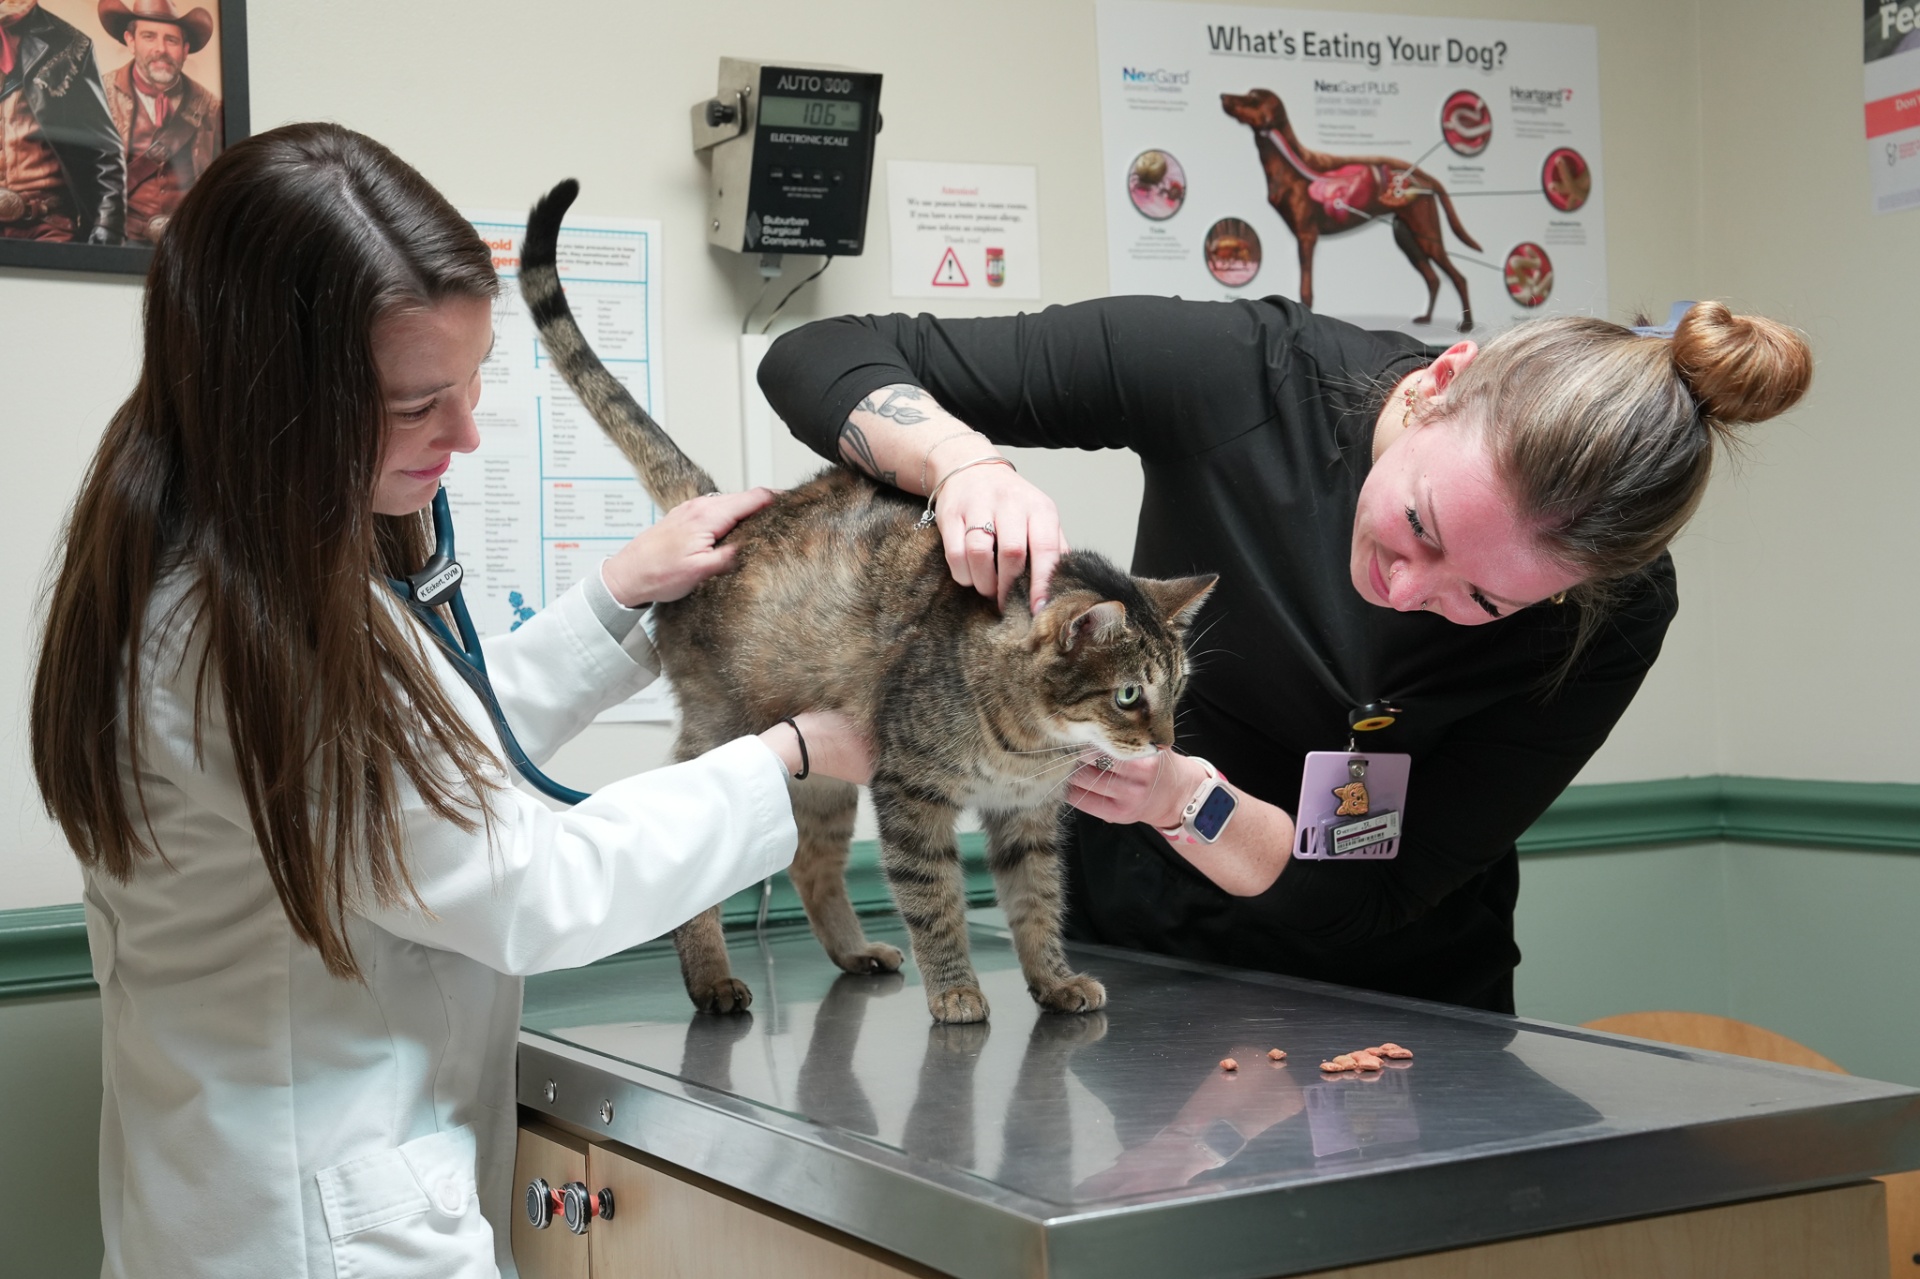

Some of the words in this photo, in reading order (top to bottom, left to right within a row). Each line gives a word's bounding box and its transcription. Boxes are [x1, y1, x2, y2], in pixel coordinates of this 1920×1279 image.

[1208, 25, 1296, 55] What's
[1303, 31, 1381, 66] Eating
[1387, 35, 1440, 62] Your
[1447, 38, 1507, 71] Dog?
[777, 74, 821, 92] AUTO
[1123, 67, 1190, 85] NexGard
[1313, 79, 1366, 94] NexGard
[1367, 81, 1400, 96] PLUS
[770, 132, 822, 145] ELECTRONIC
[823, 135, 849, 147] SCALE
[763, 214, 809, 226] Suburban
[762, 225, 802, 237] Surgical
[761, 235, 809, 248] Company,
[809, 237, 826, 247] Inc.
[420, 589, 427, 598] K
[425, 579, 446, 594] Eckert,
[444, 567, 459, 581] DVM
